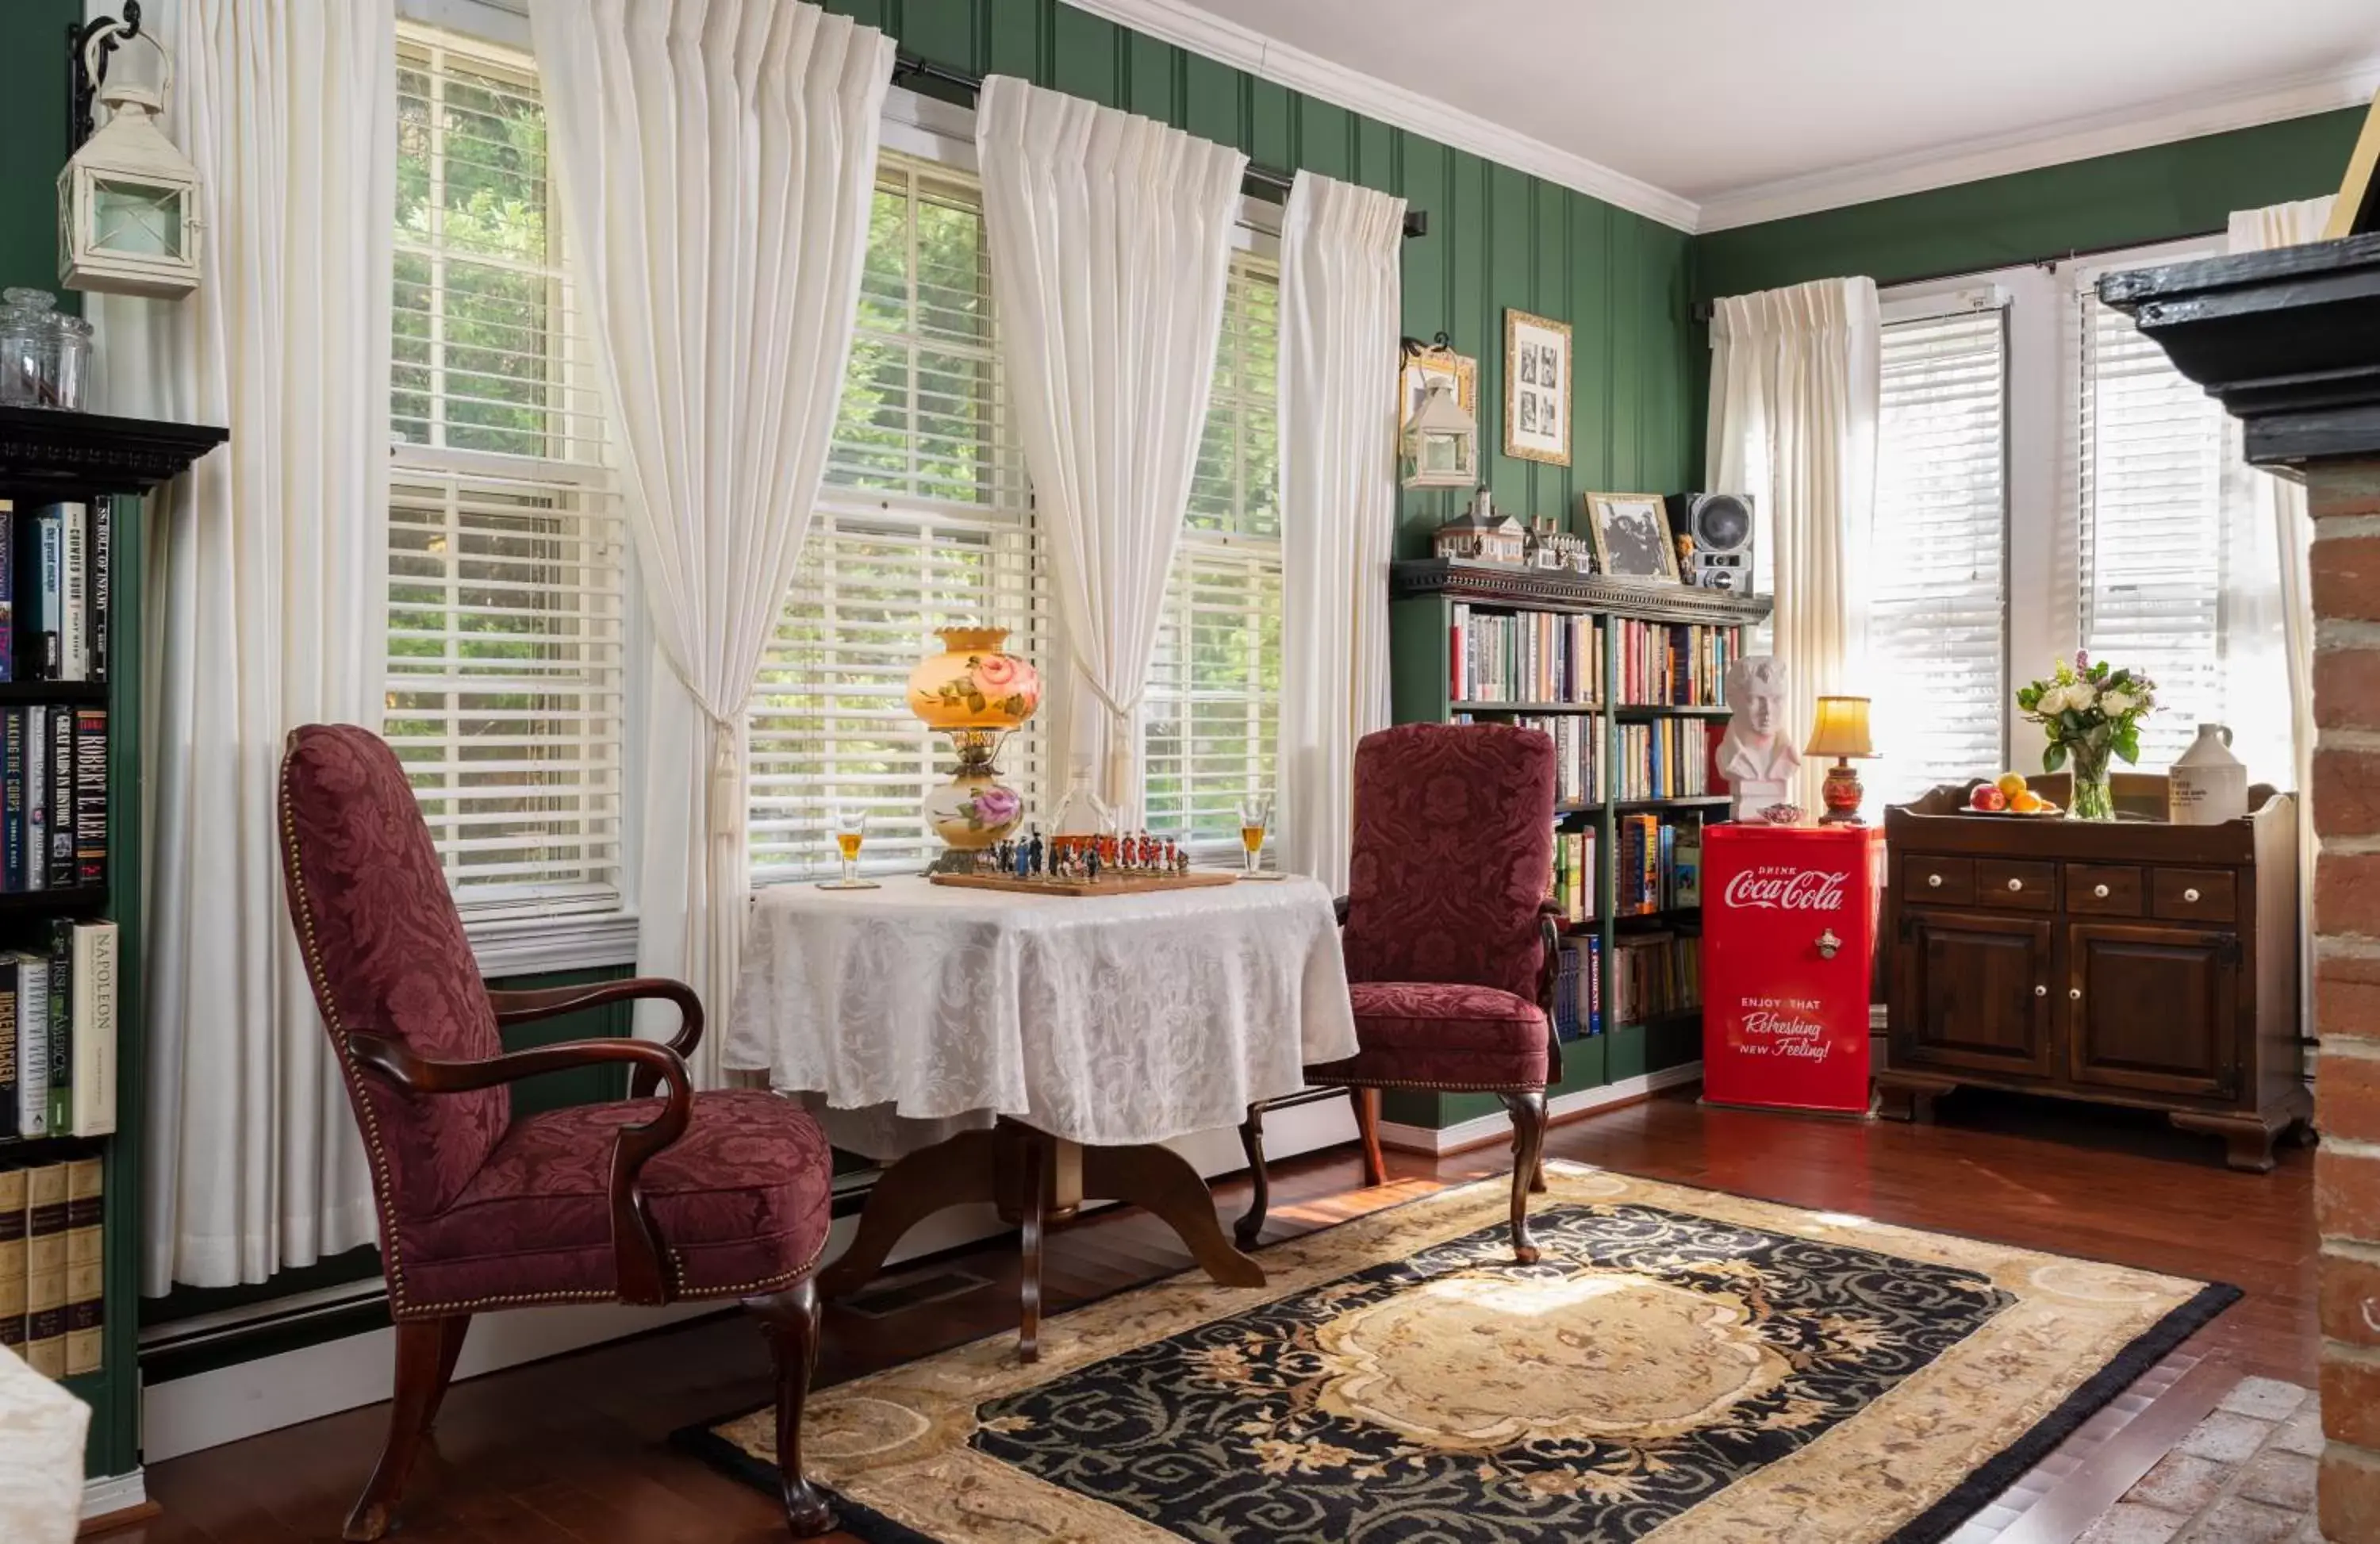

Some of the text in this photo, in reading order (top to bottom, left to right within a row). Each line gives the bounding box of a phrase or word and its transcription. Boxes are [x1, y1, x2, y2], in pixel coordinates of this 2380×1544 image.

[70, 529, 81, 572] CROWDED
[97, 524, 108, 553] ROLL
[96, 572, 107, 611] INFAMY
[7, 714, 21, 753] MAKING
[7, 755, 21, 774] THE
[56, 714, 71, 828] GREAT RAIDS IN HISTORY
[77, 735, 107, 792] ROBERT
[7, 778, 21, 812] CORPS
[77, 796, 107, 810] E.
[77, 812, 107, 839] LEE
[1757, 866, 1797, 876] DRINK
[1724, 870, 1851, 910] Coca-Cola
[96, 934, 110, 1029] NAPOLEON
[1741, 997, 1821, 1010] ENJOY THAT
[1741, 1012, 1822, 1042] Refreshing
[1740, 1037, 1832, 1064] NEW Feeling!
